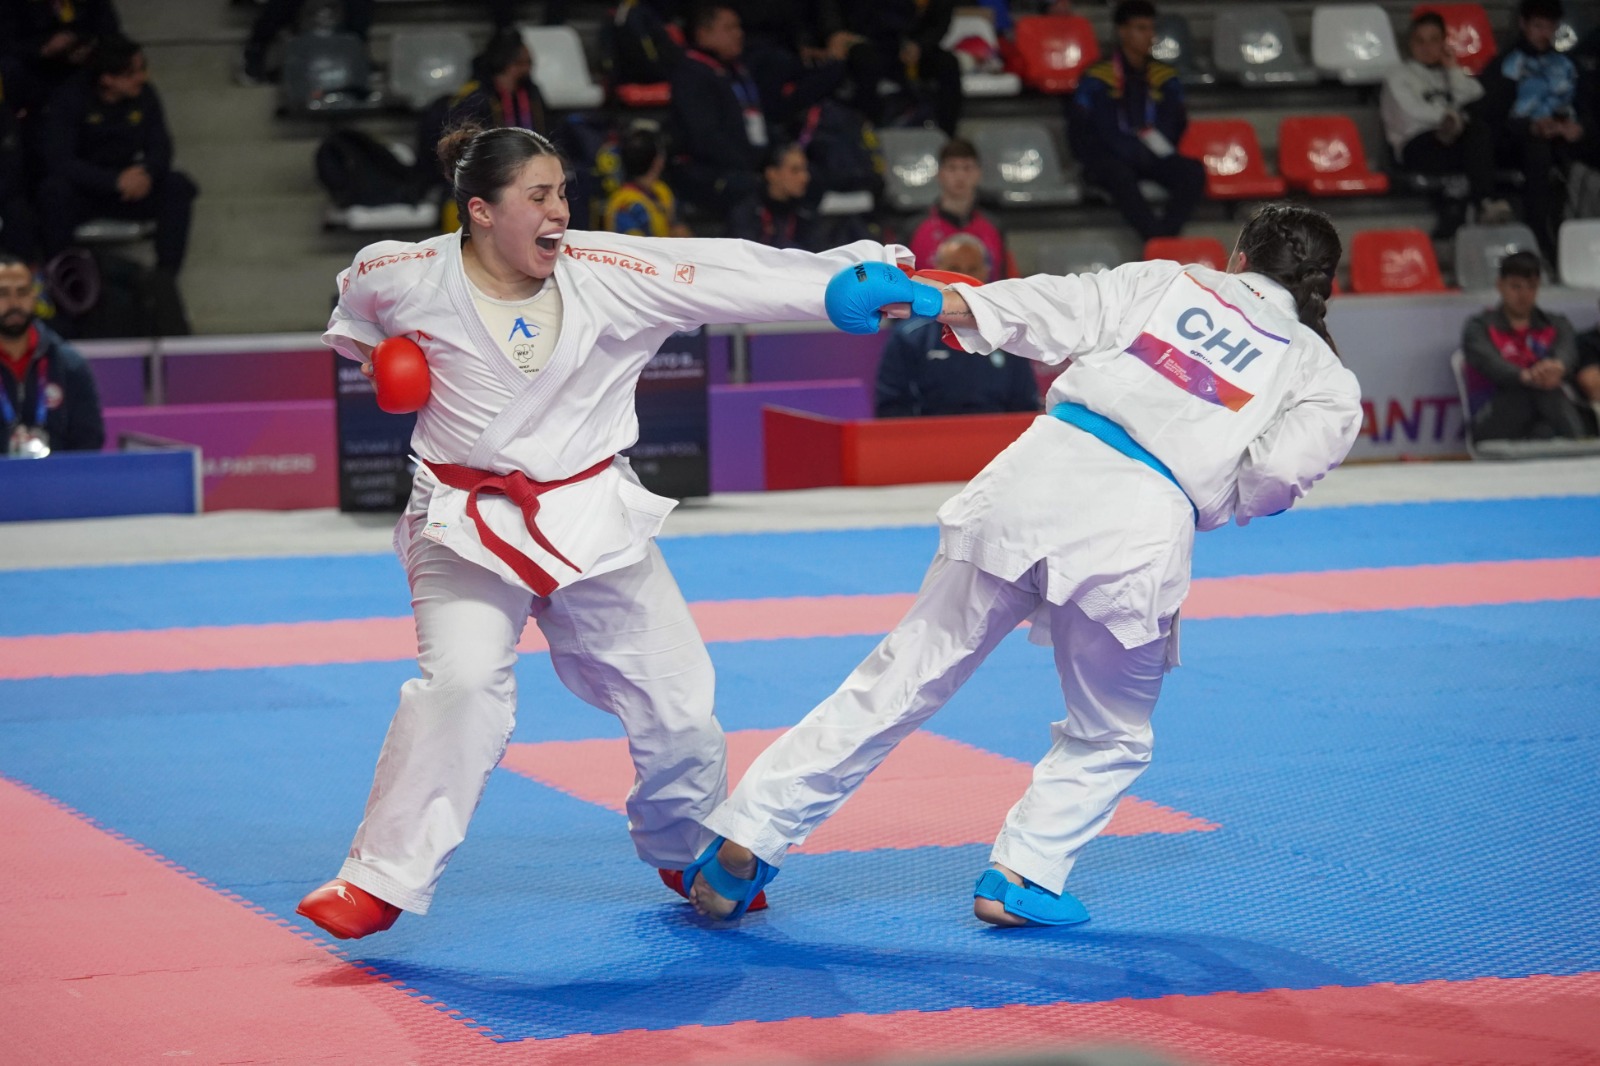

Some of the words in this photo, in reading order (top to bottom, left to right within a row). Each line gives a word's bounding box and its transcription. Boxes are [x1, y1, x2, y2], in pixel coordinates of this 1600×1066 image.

[562, 243, 660, 277] Arawaza
[1176, 307, 1264, 373] CHI
[1359, 397, 1465, 442] ANT
